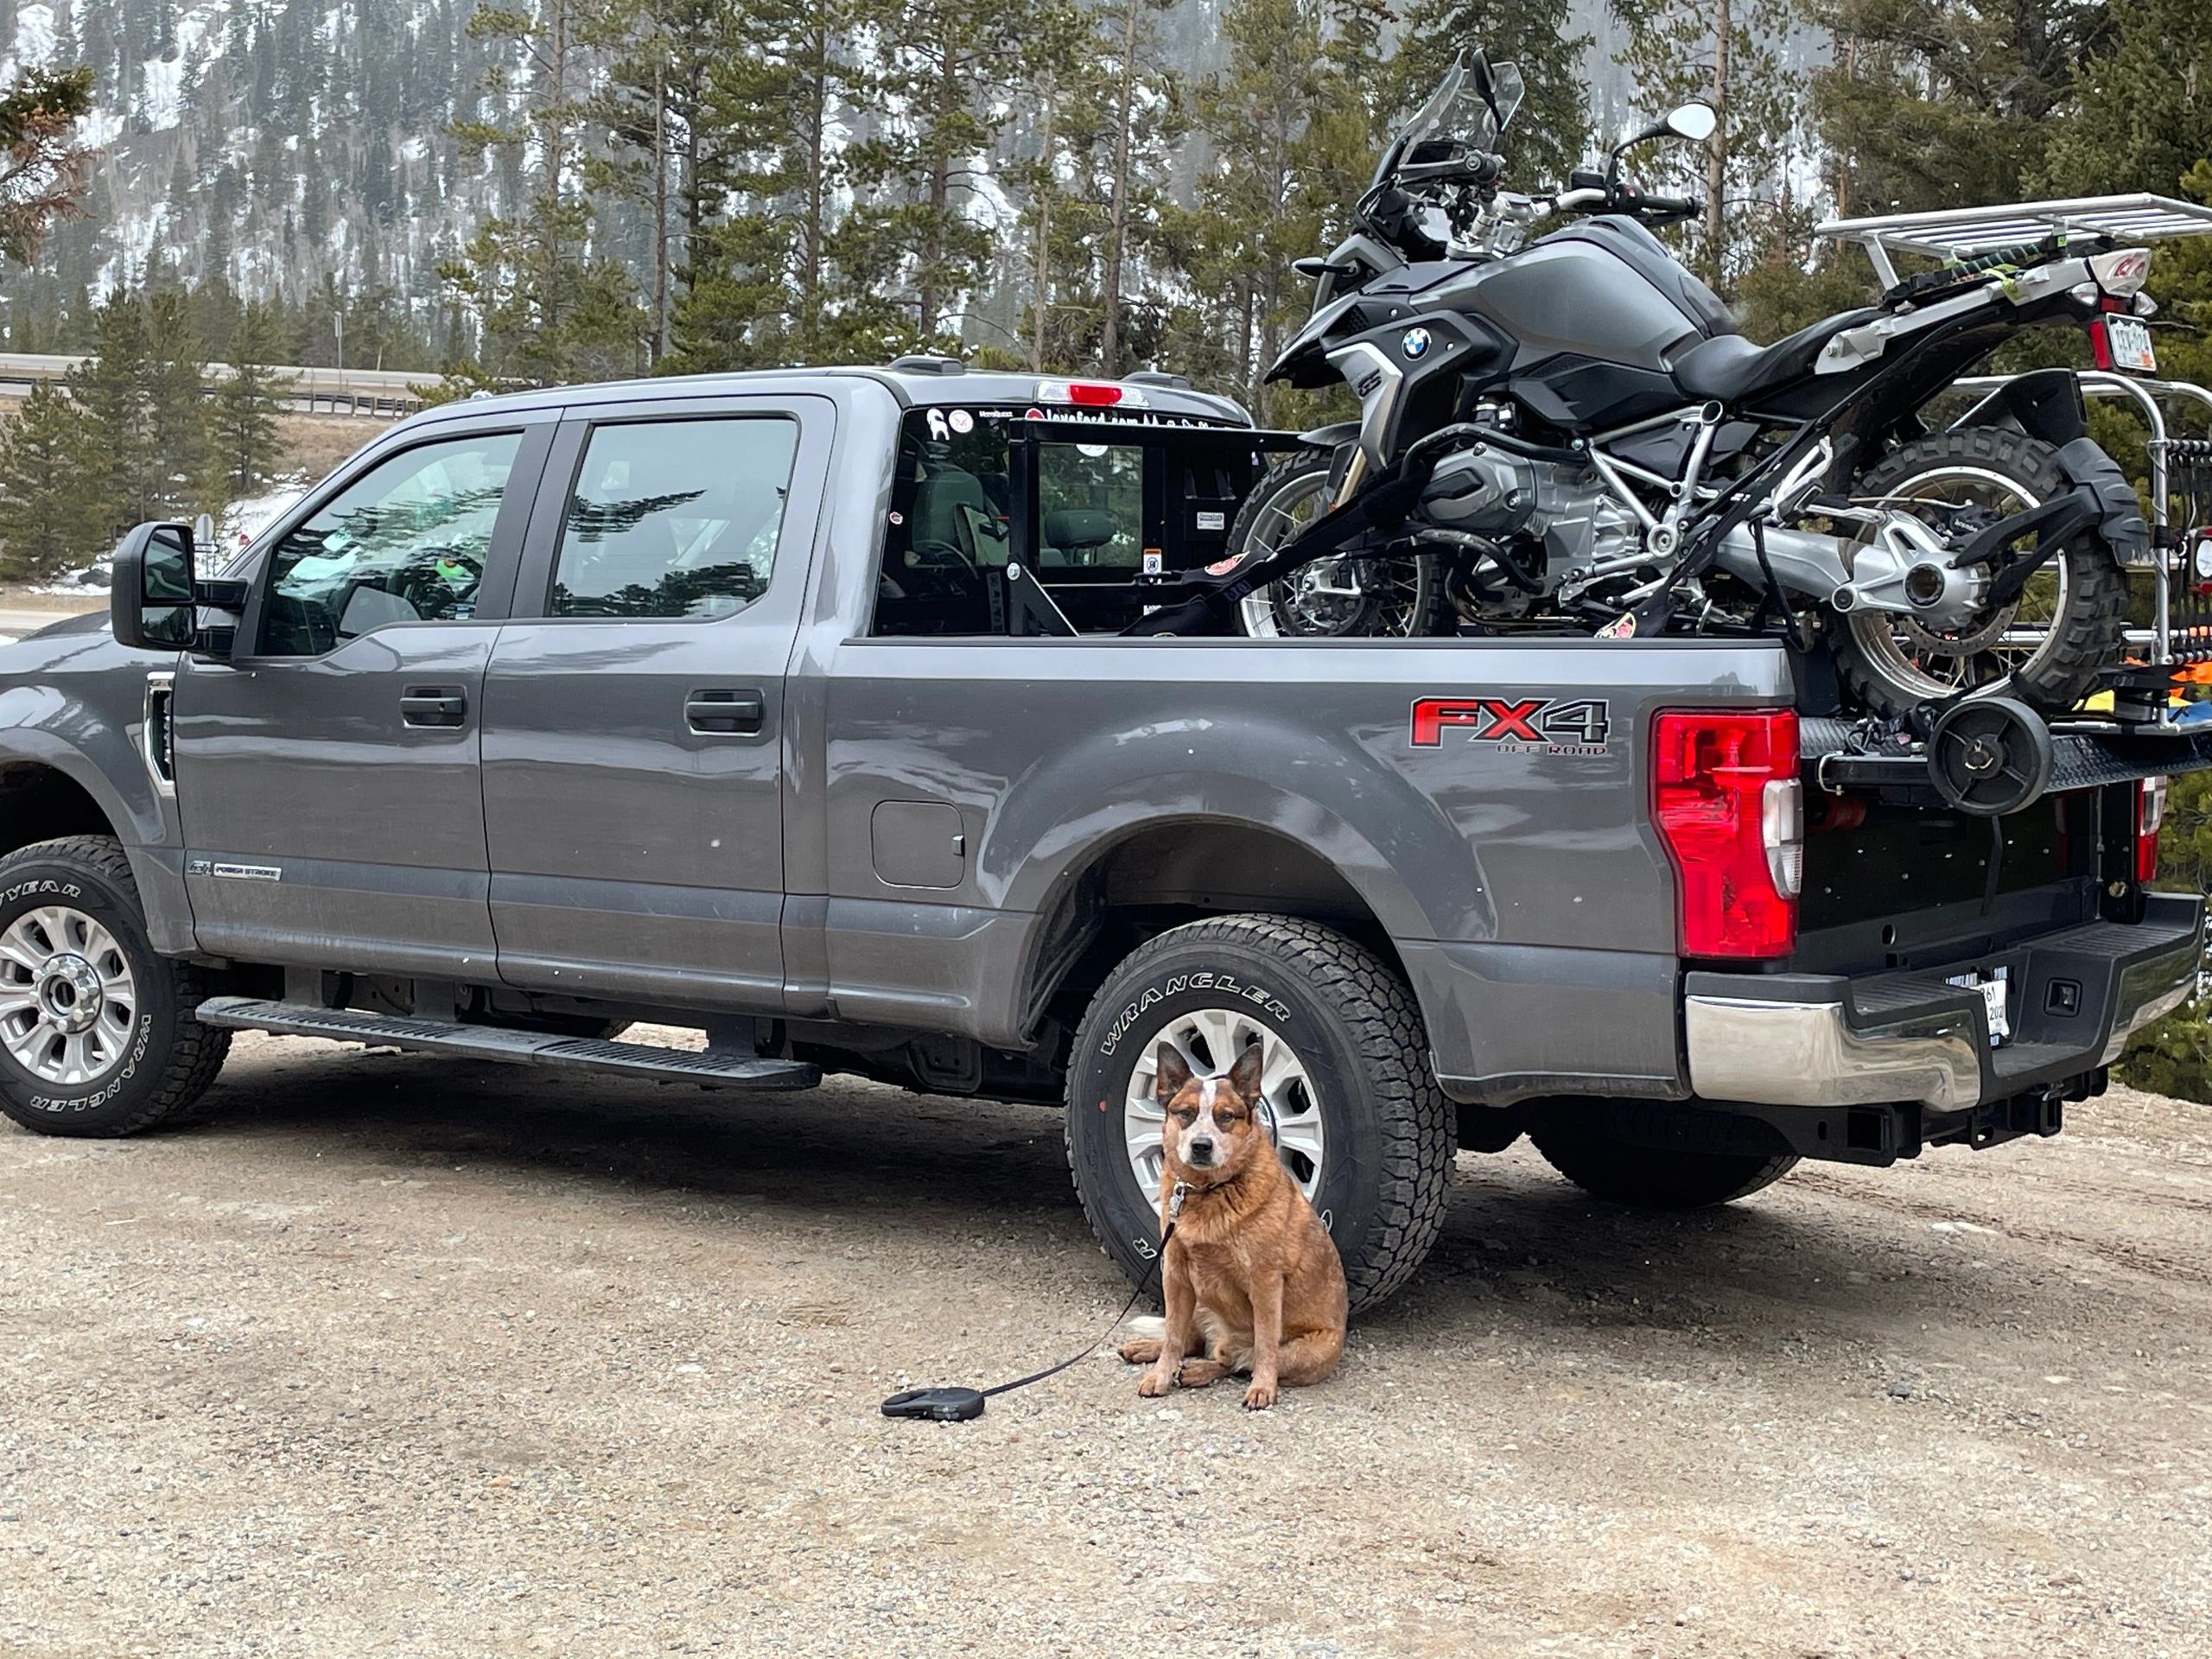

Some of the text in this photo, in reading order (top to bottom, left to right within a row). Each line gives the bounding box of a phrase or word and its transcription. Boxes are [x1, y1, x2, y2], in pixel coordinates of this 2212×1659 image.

[1409, 695, 1611, 749] FX4
[1496, 743, 1608, 756] OFF ROAD
[1099, 972, 1293, 1058] WRANGLER
[29, 1014, 153, 1114] WRANGLER
